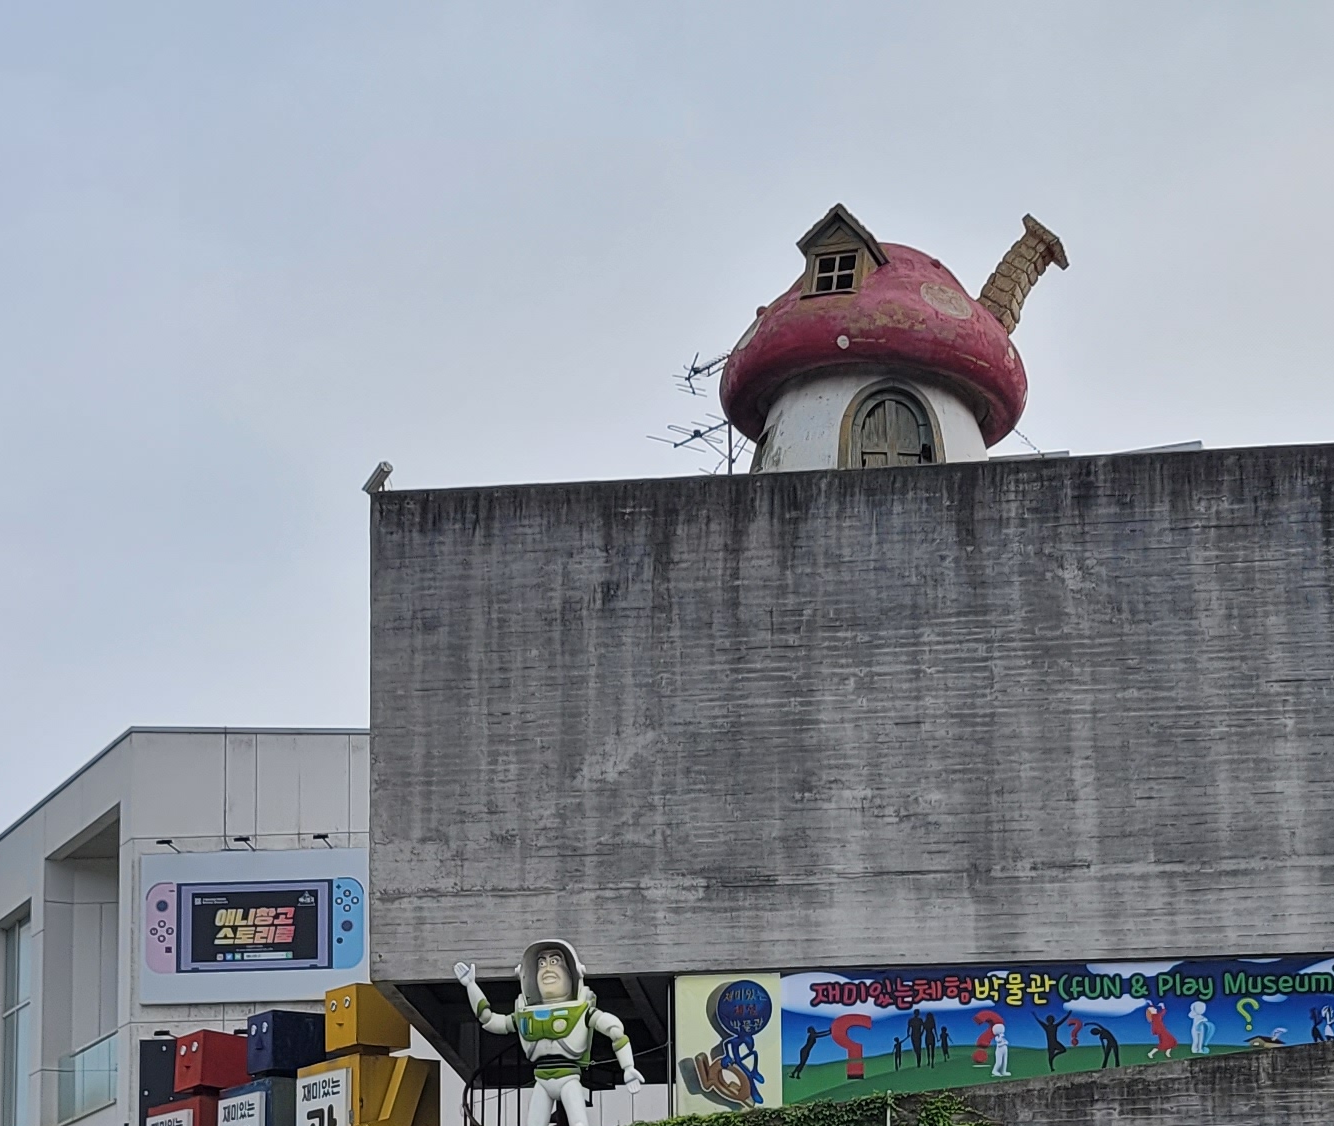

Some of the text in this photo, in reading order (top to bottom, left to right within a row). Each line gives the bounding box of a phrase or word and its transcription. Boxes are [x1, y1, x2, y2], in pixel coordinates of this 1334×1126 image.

[214, 907, 295, 926] 애니창고
[723, 988, 768, 1003] 재미있는
[1158, 972, 1213, 999] Play
[730, 1017, 764, 1033] 박물관
[302, 1077, 341, 1102] 재미있는
[222, 1100, 255, 1123] 재미있는
